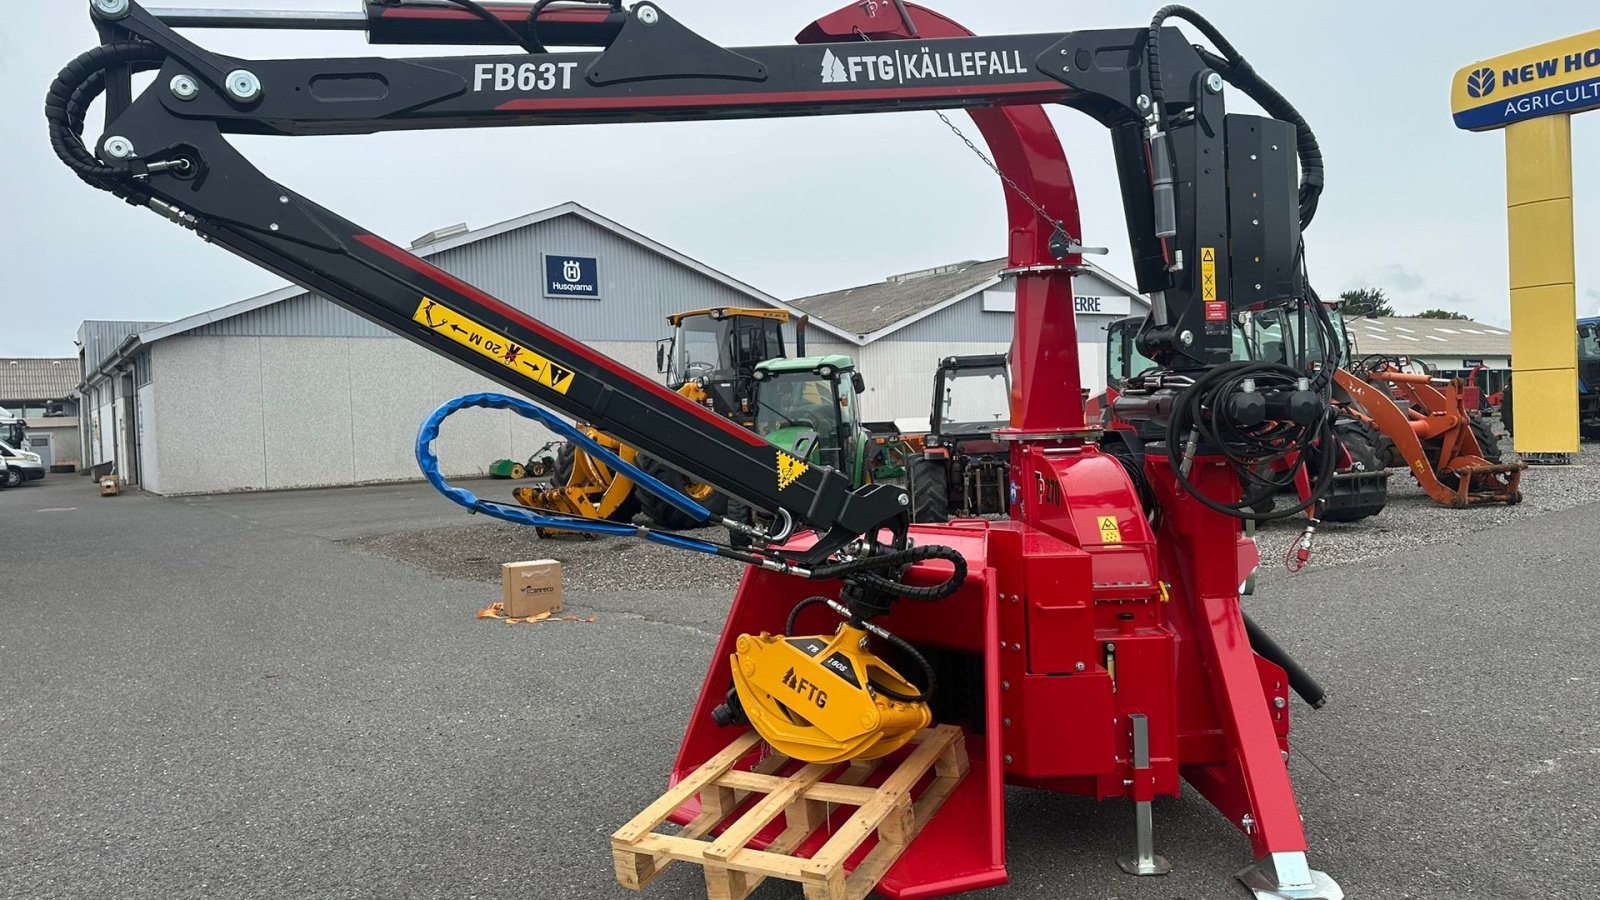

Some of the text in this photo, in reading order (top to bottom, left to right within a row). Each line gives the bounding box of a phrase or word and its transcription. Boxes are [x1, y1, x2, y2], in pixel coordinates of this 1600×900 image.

[473, 62, 578, 92] FB63T
[1502, 58, 1559, 88] NEW
[552, 281, 593, 292] Husqvarna
[468, 332, 502, 354] 20 M
[827, 657, 848, 672] 160S
[796, 677, 828, 709] FTG
